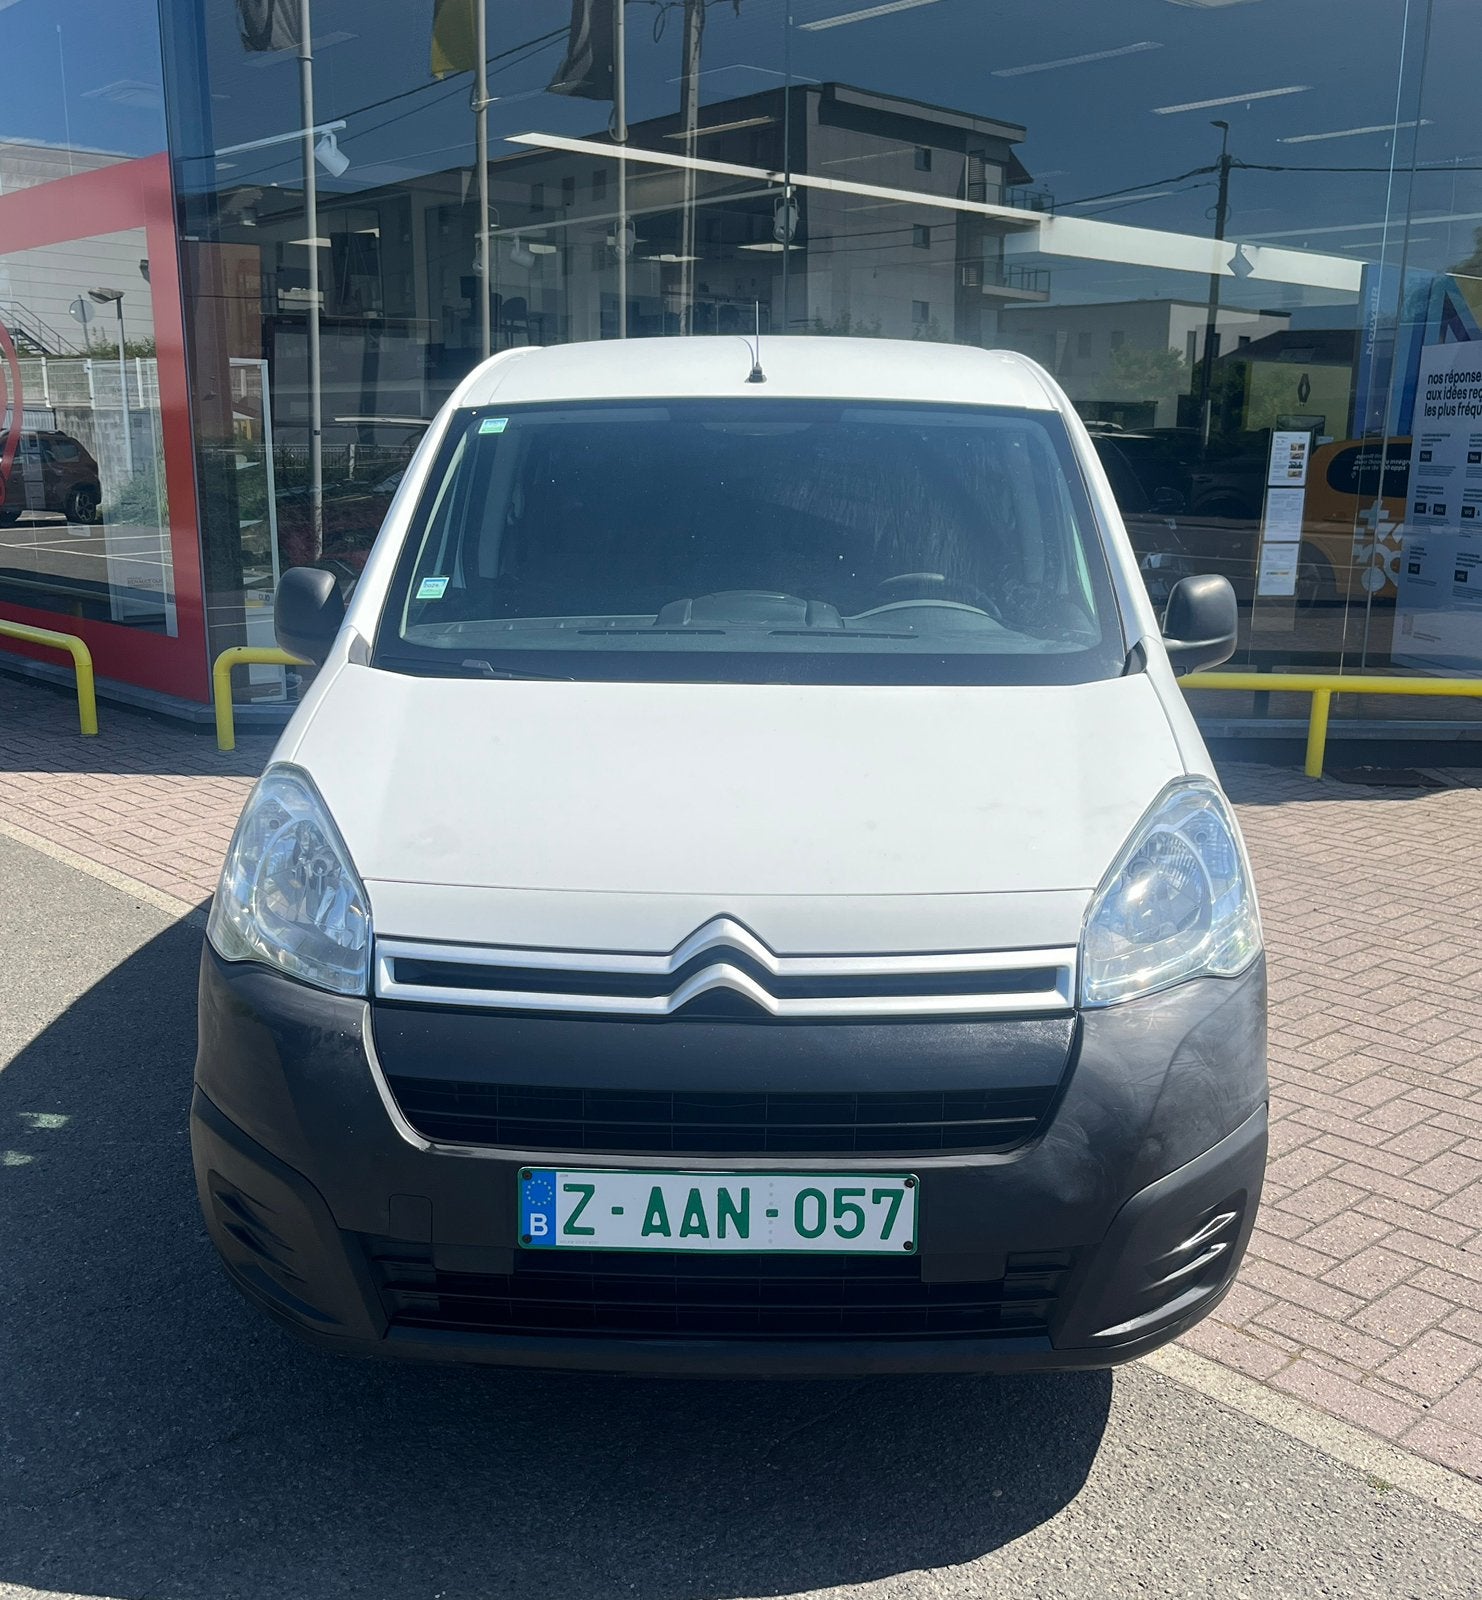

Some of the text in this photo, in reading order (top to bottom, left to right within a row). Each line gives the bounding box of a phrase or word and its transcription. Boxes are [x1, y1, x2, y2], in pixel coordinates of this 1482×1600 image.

[1427, 373, 1443, 385] nos
[1426, 389, 1442, 401] aux
[1443, 386, 1468, 400] idées
[1424, 402, 1437, 417] les
[1437, 401, 1457, 420] plus
[530, 1213, 549, 1236] B
